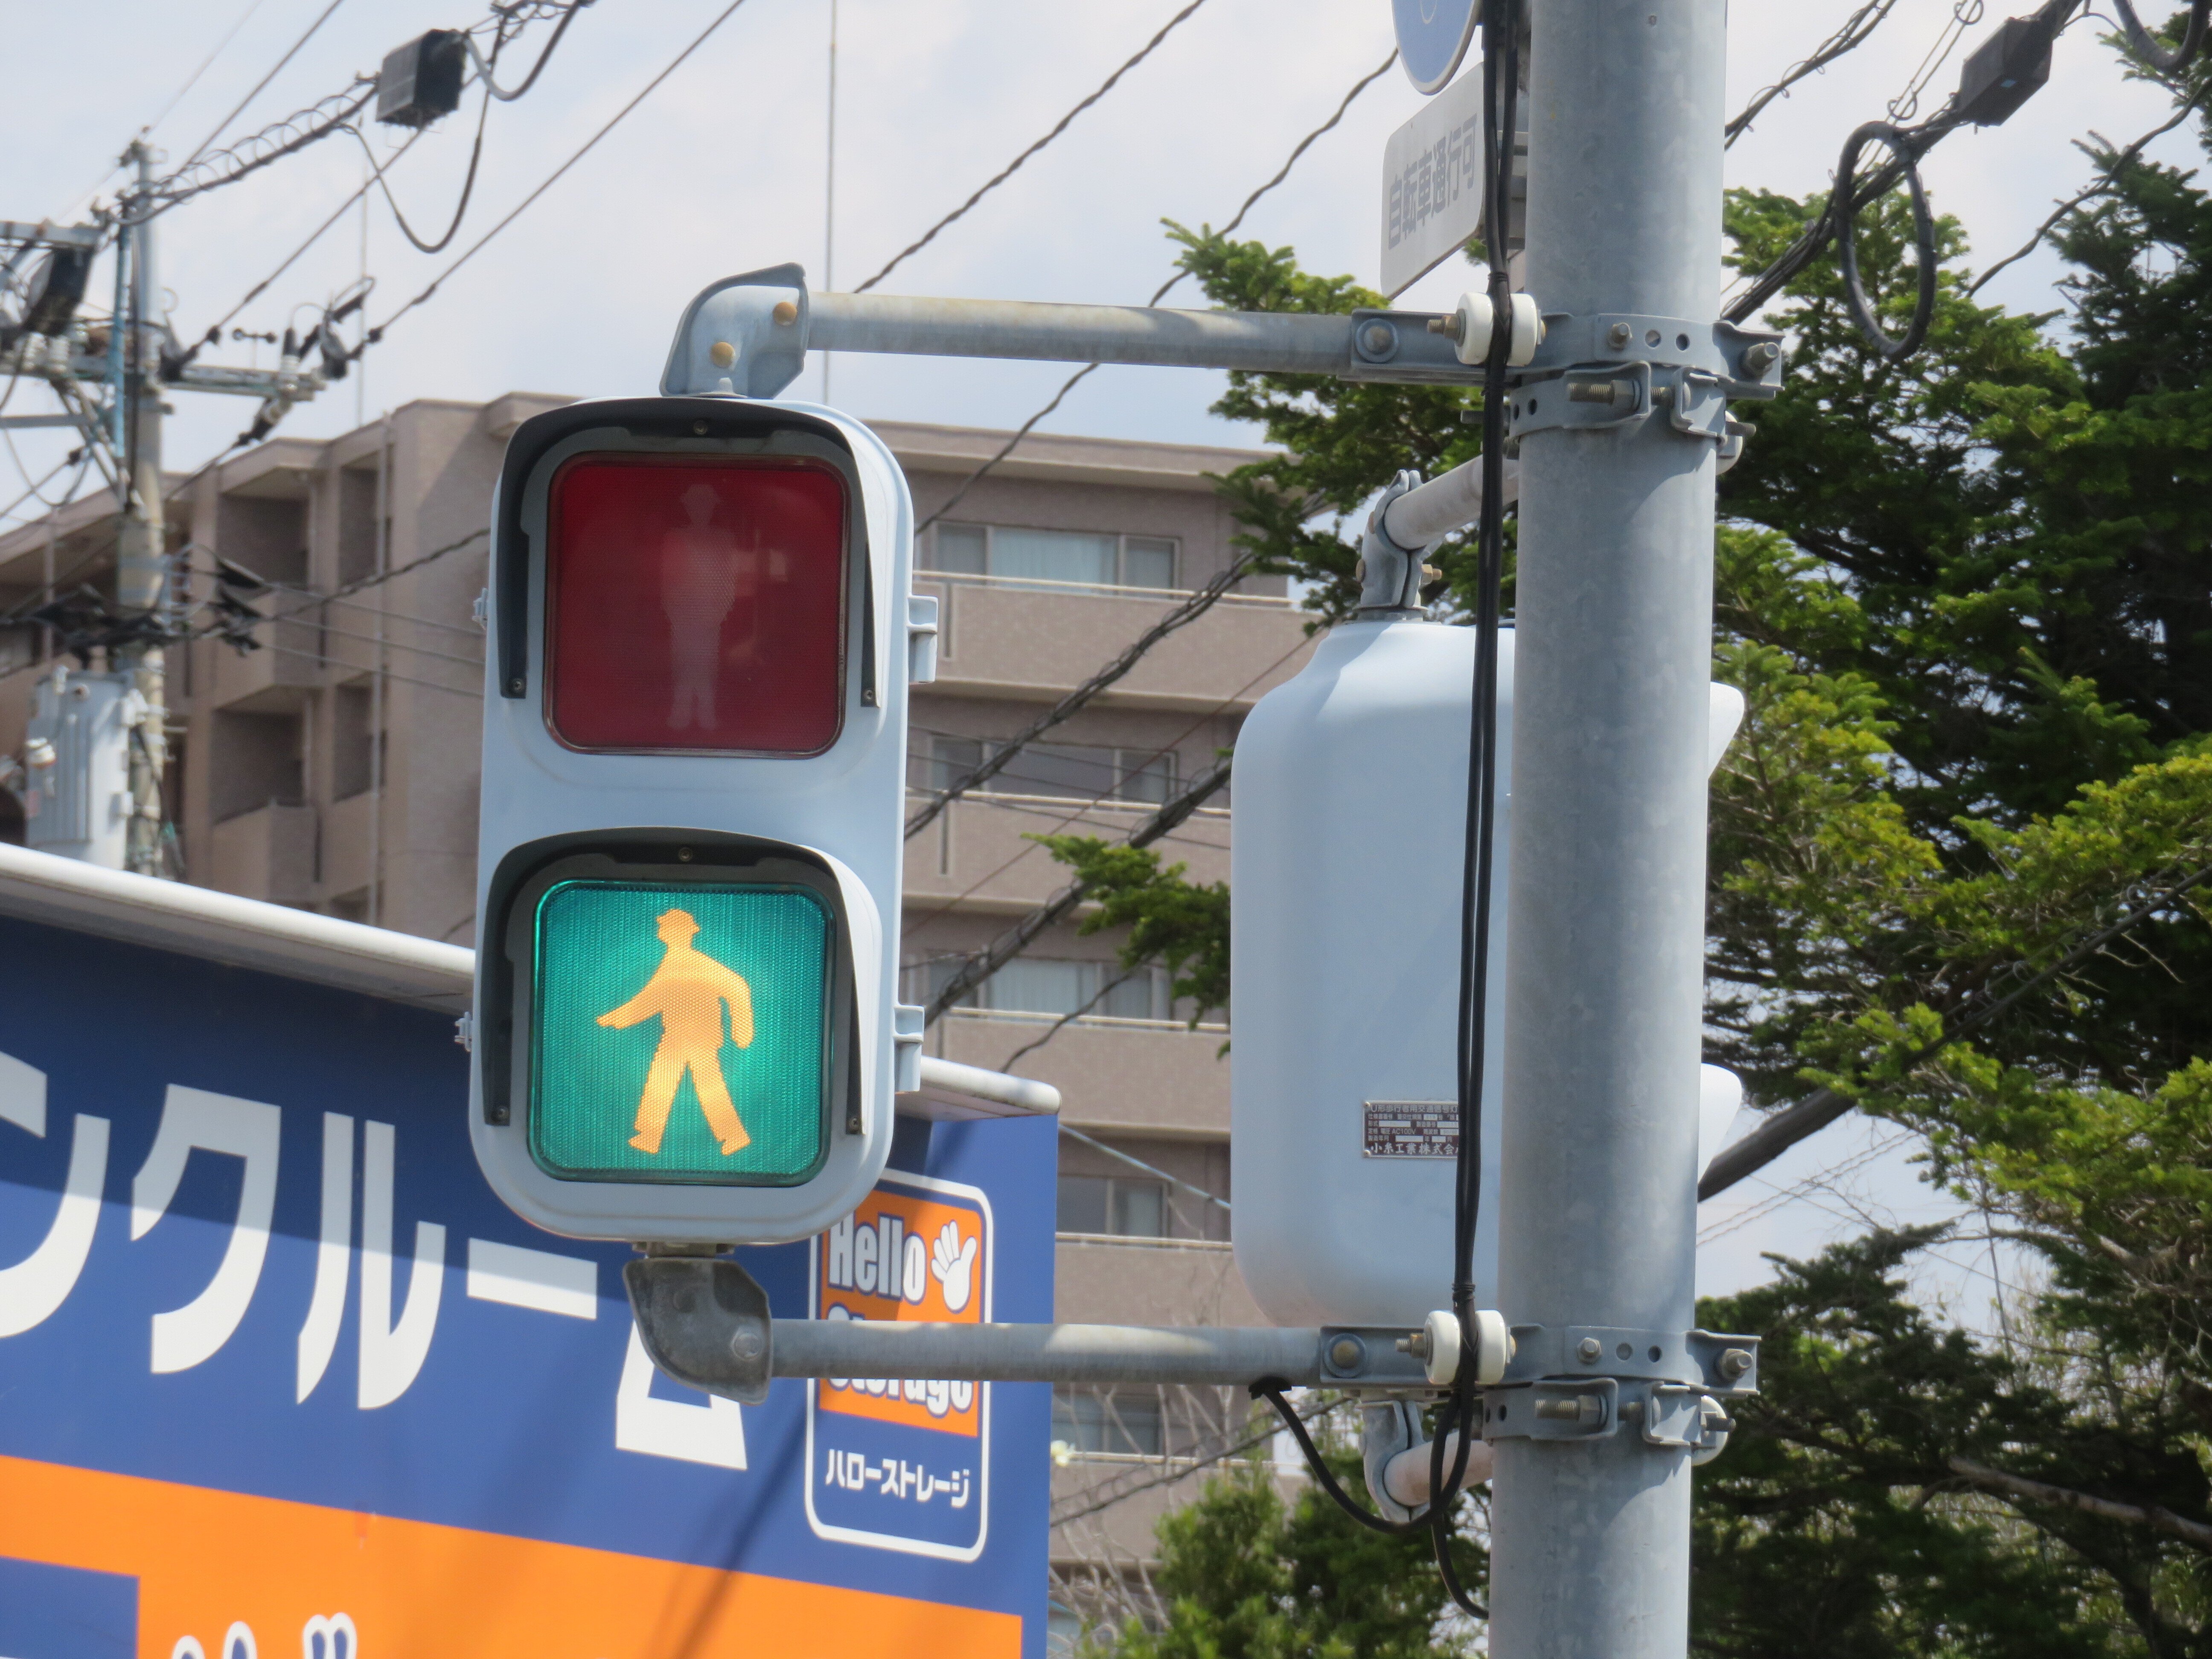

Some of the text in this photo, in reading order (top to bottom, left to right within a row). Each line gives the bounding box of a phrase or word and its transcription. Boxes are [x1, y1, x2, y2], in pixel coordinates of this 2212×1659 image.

[1388, 113, 1478, 250] 自転車通行可
[828, 1213, 928, 1304] Hello
[825, 1448, 970, 1508] ハローストレージ
